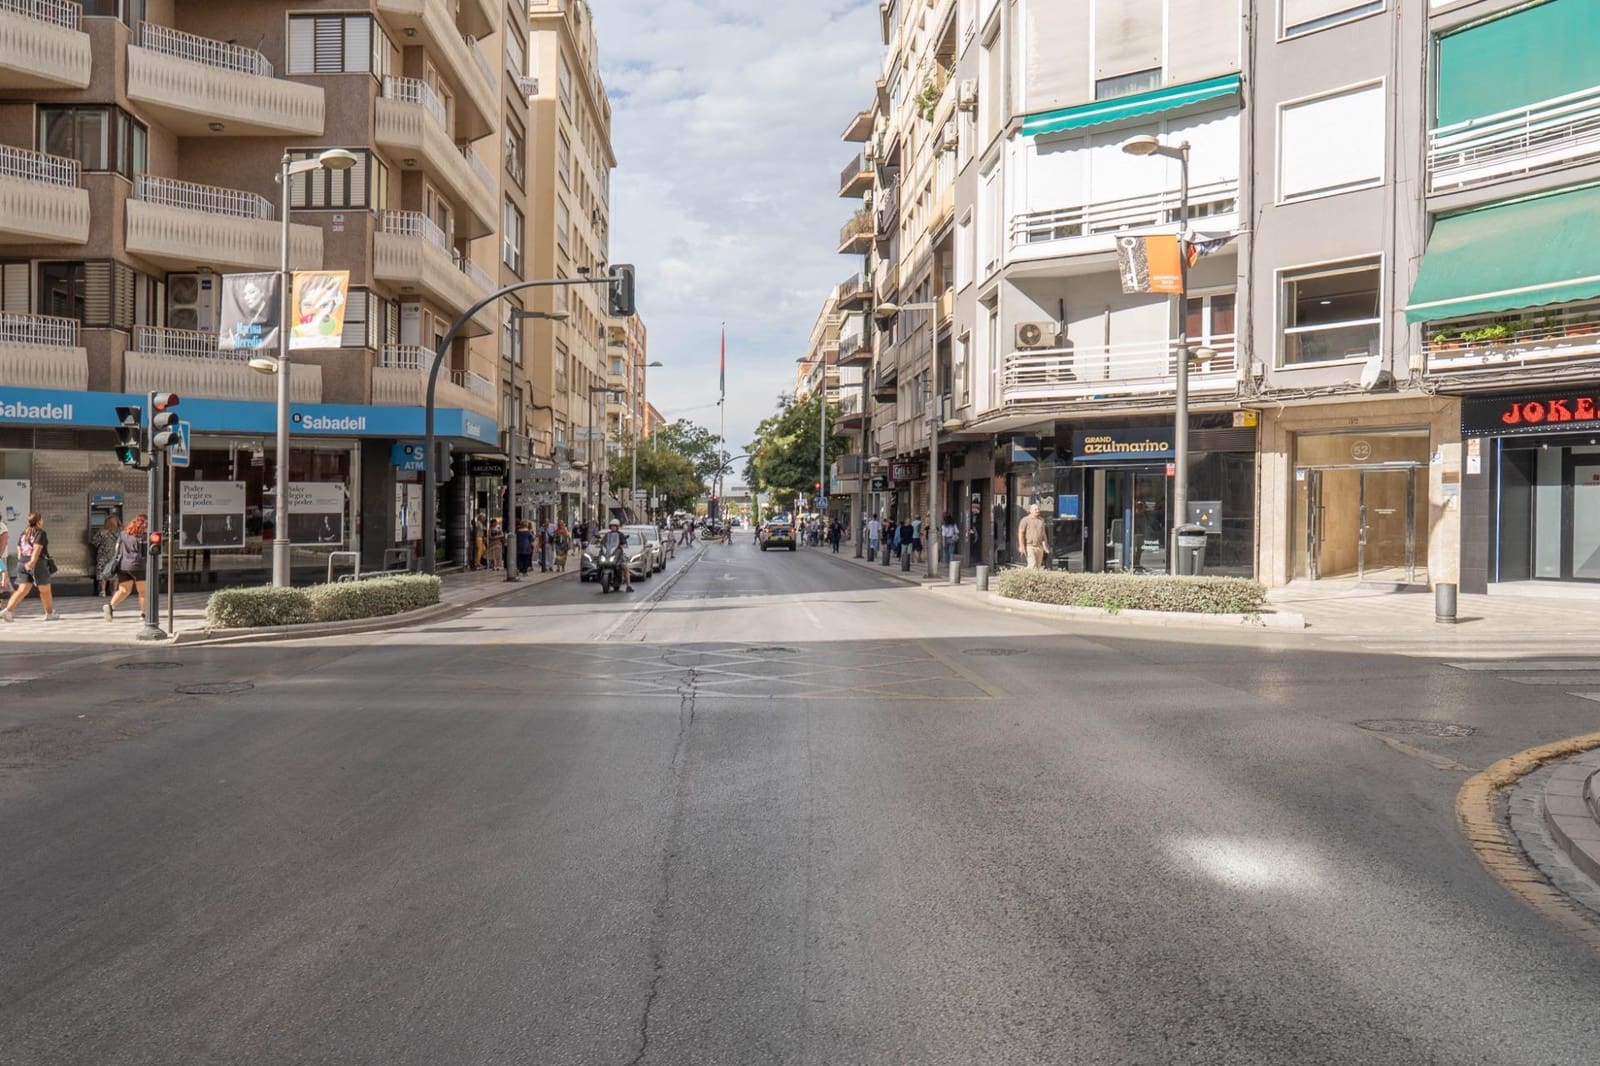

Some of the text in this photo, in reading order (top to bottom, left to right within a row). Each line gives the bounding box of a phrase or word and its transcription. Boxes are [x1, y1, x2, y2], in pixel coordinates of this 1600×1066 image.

[1502, 398, 1600, 424] JOKE
[302, 415, 366, 430] Sabadell
[1084, 436, 1112, 444] GRAND
[1084, 440, 1169, 453] azulmarino
[414, 447, 424, 460] S
[404, 461, 424, 470] ATM
